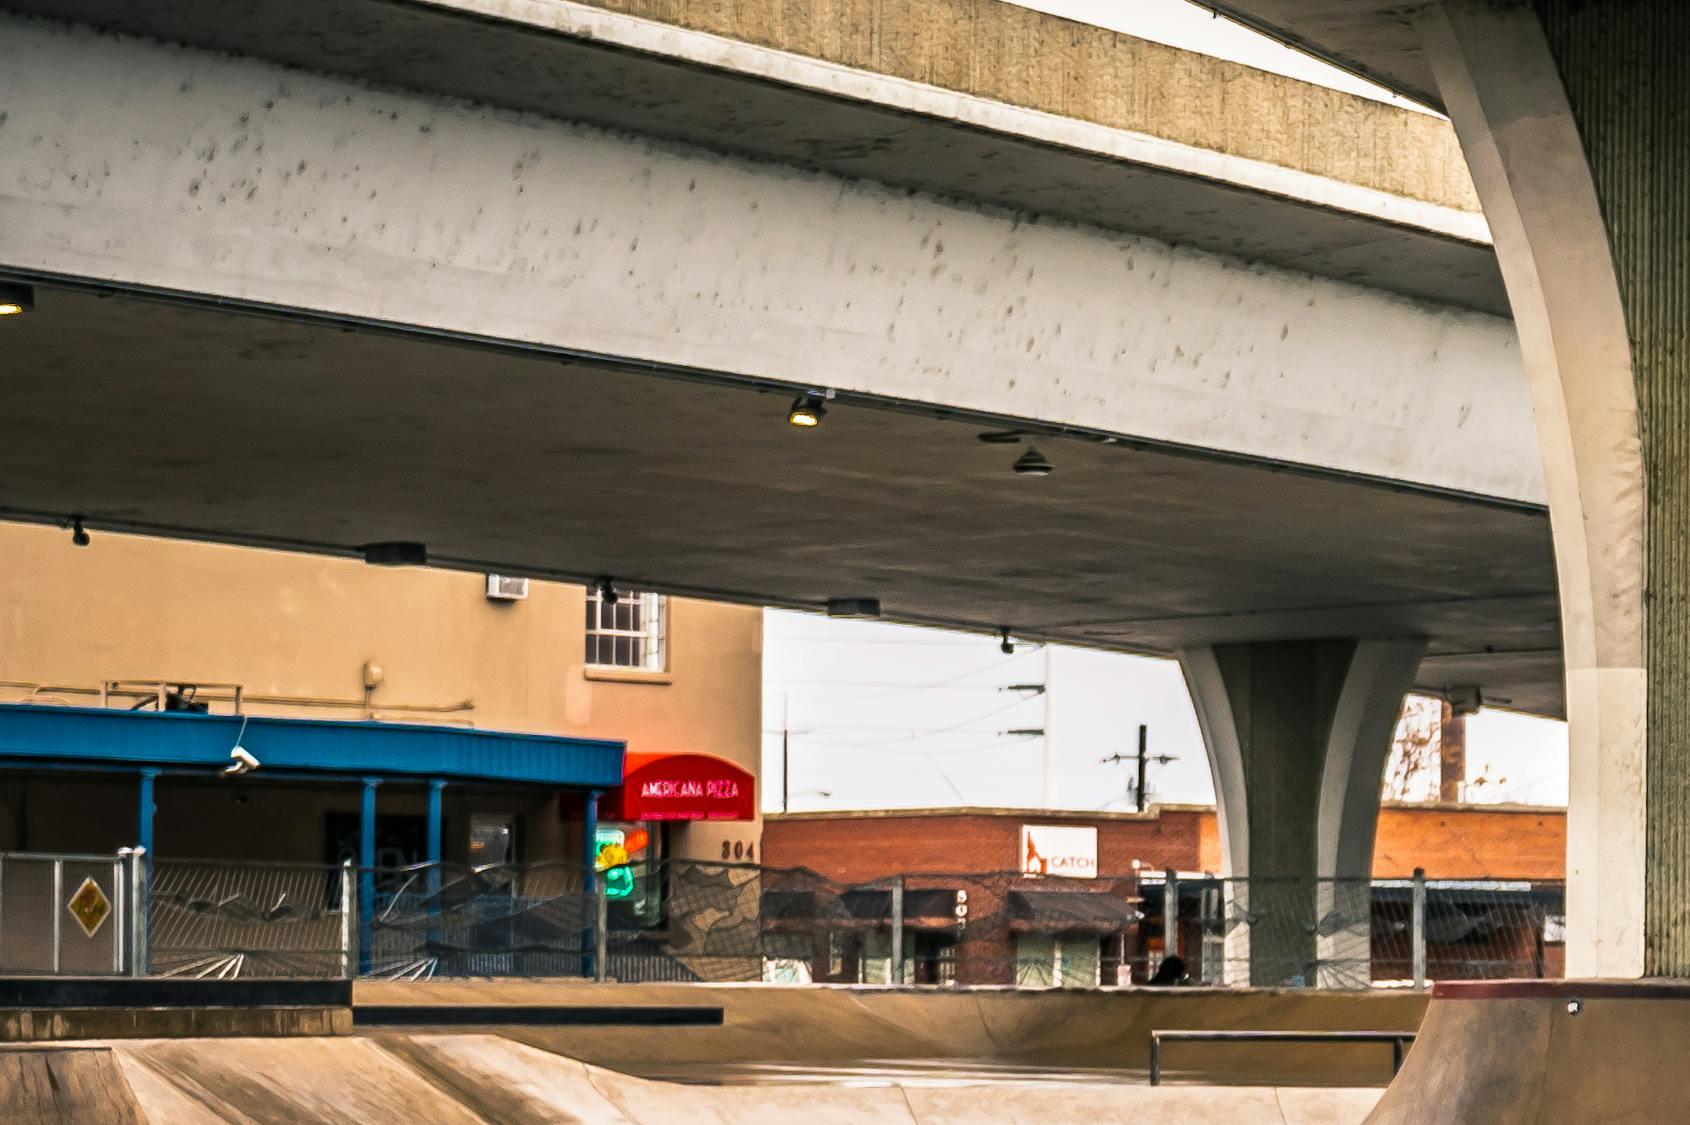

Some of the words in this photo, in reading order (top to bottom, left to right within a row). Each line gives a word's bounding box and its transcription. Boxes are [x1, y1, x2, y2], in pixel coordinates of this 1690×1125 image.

[641, 780, 703, 798] AMERICANA
[706, 780, 739, 798] PIZZA
[1051, 856, 1094, 868] CATCH
